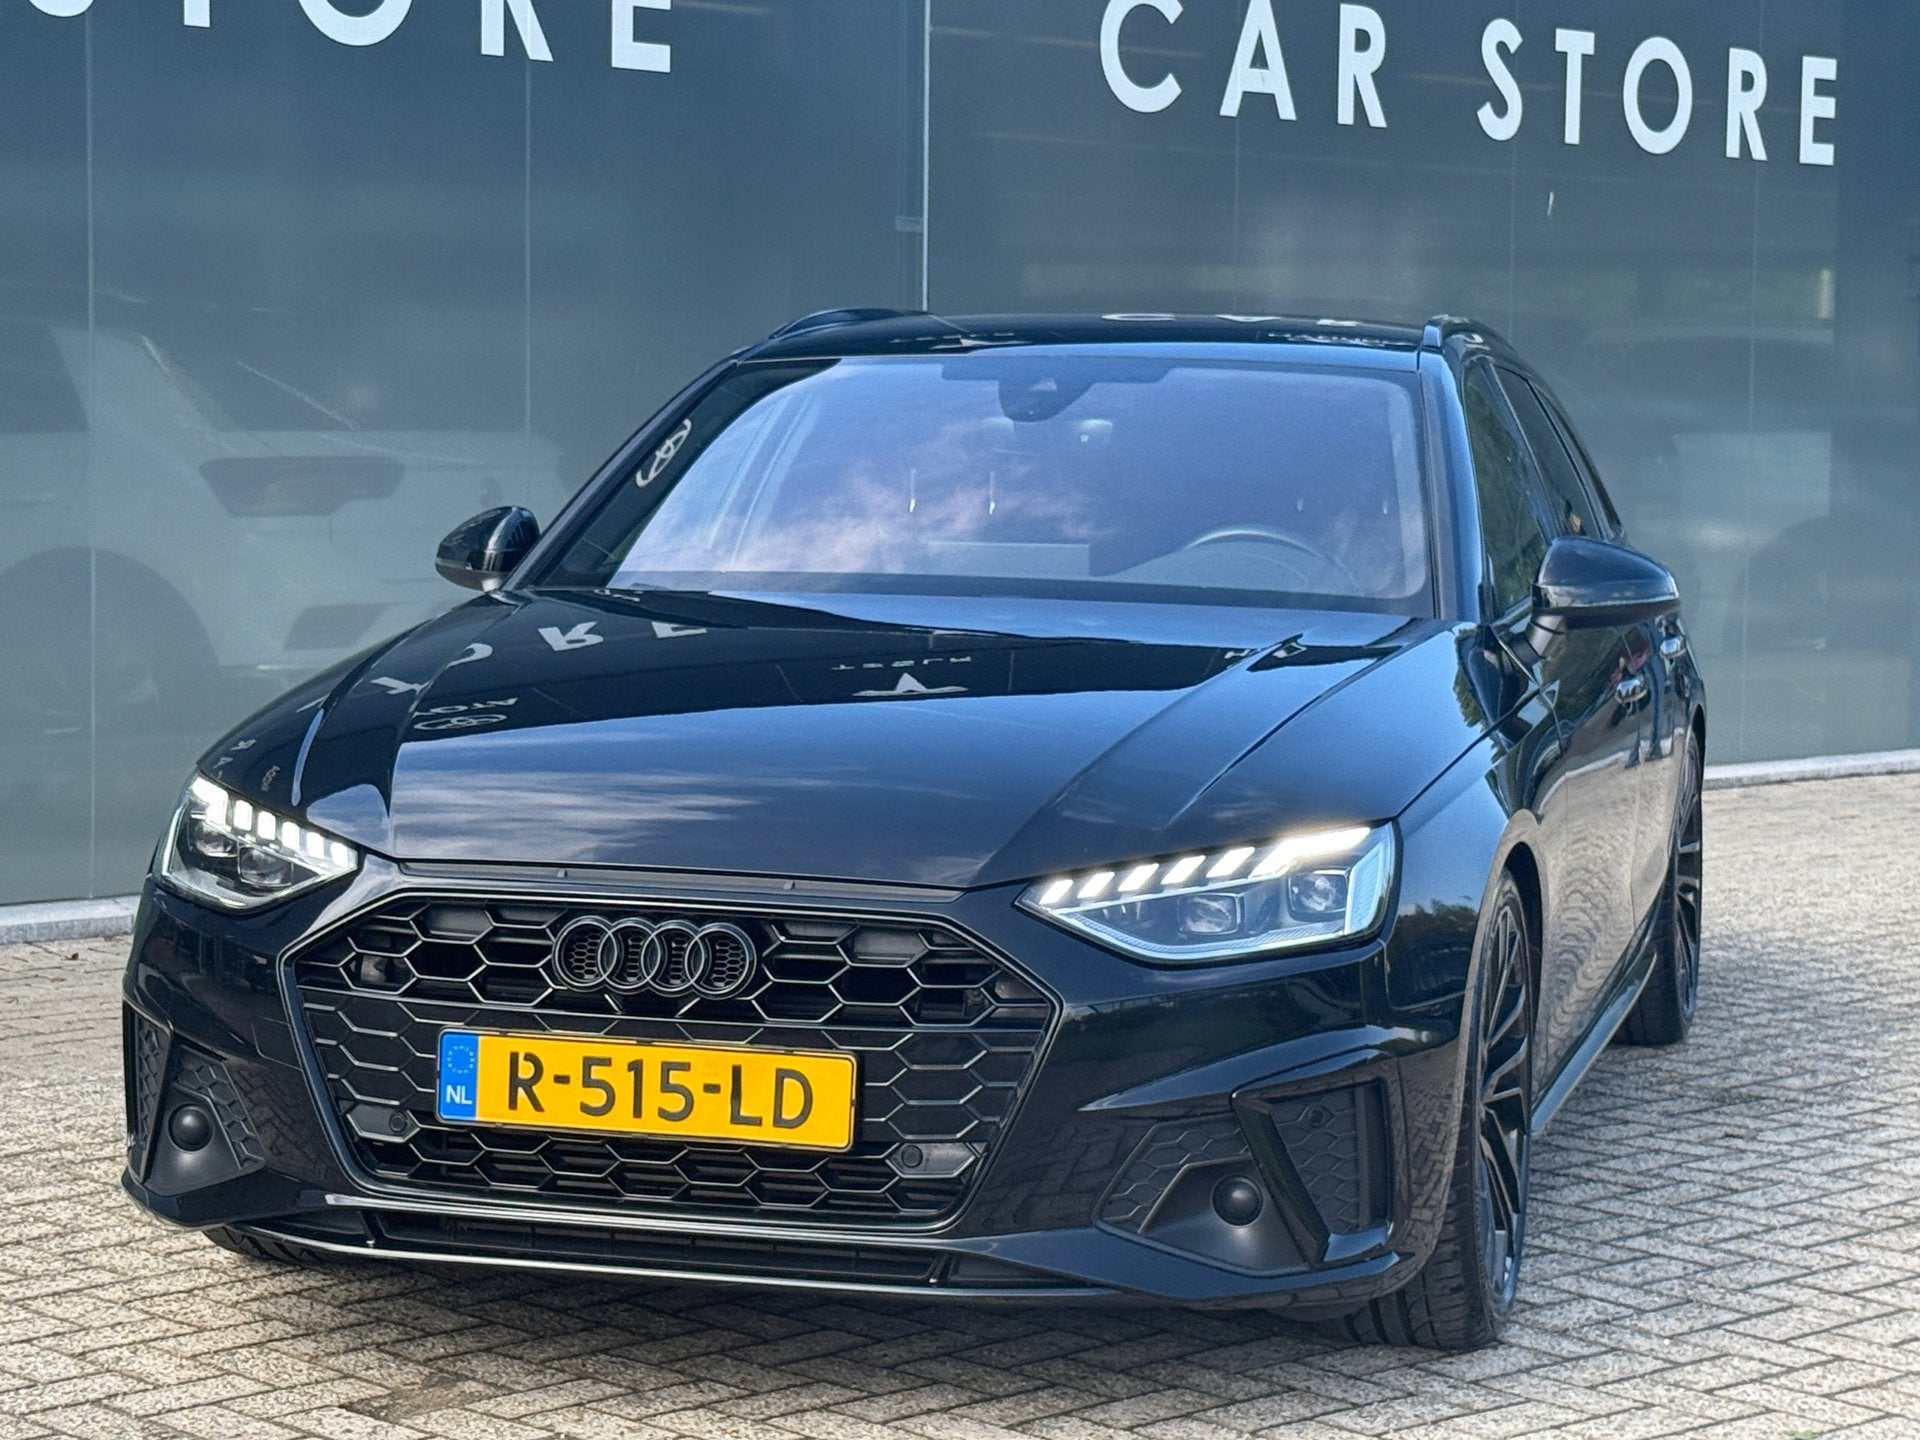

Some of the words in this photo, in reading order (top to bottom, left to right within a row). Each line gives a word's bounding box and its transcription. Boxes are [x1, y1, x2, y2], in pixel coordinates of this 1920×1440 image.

[1100, 0, 1388, 128] CAR
[1476, 18, 1838, 166] STORE
[446, 1084, 473, 1106] NL
[508, 1051, 814, 1129] R-515-LD
